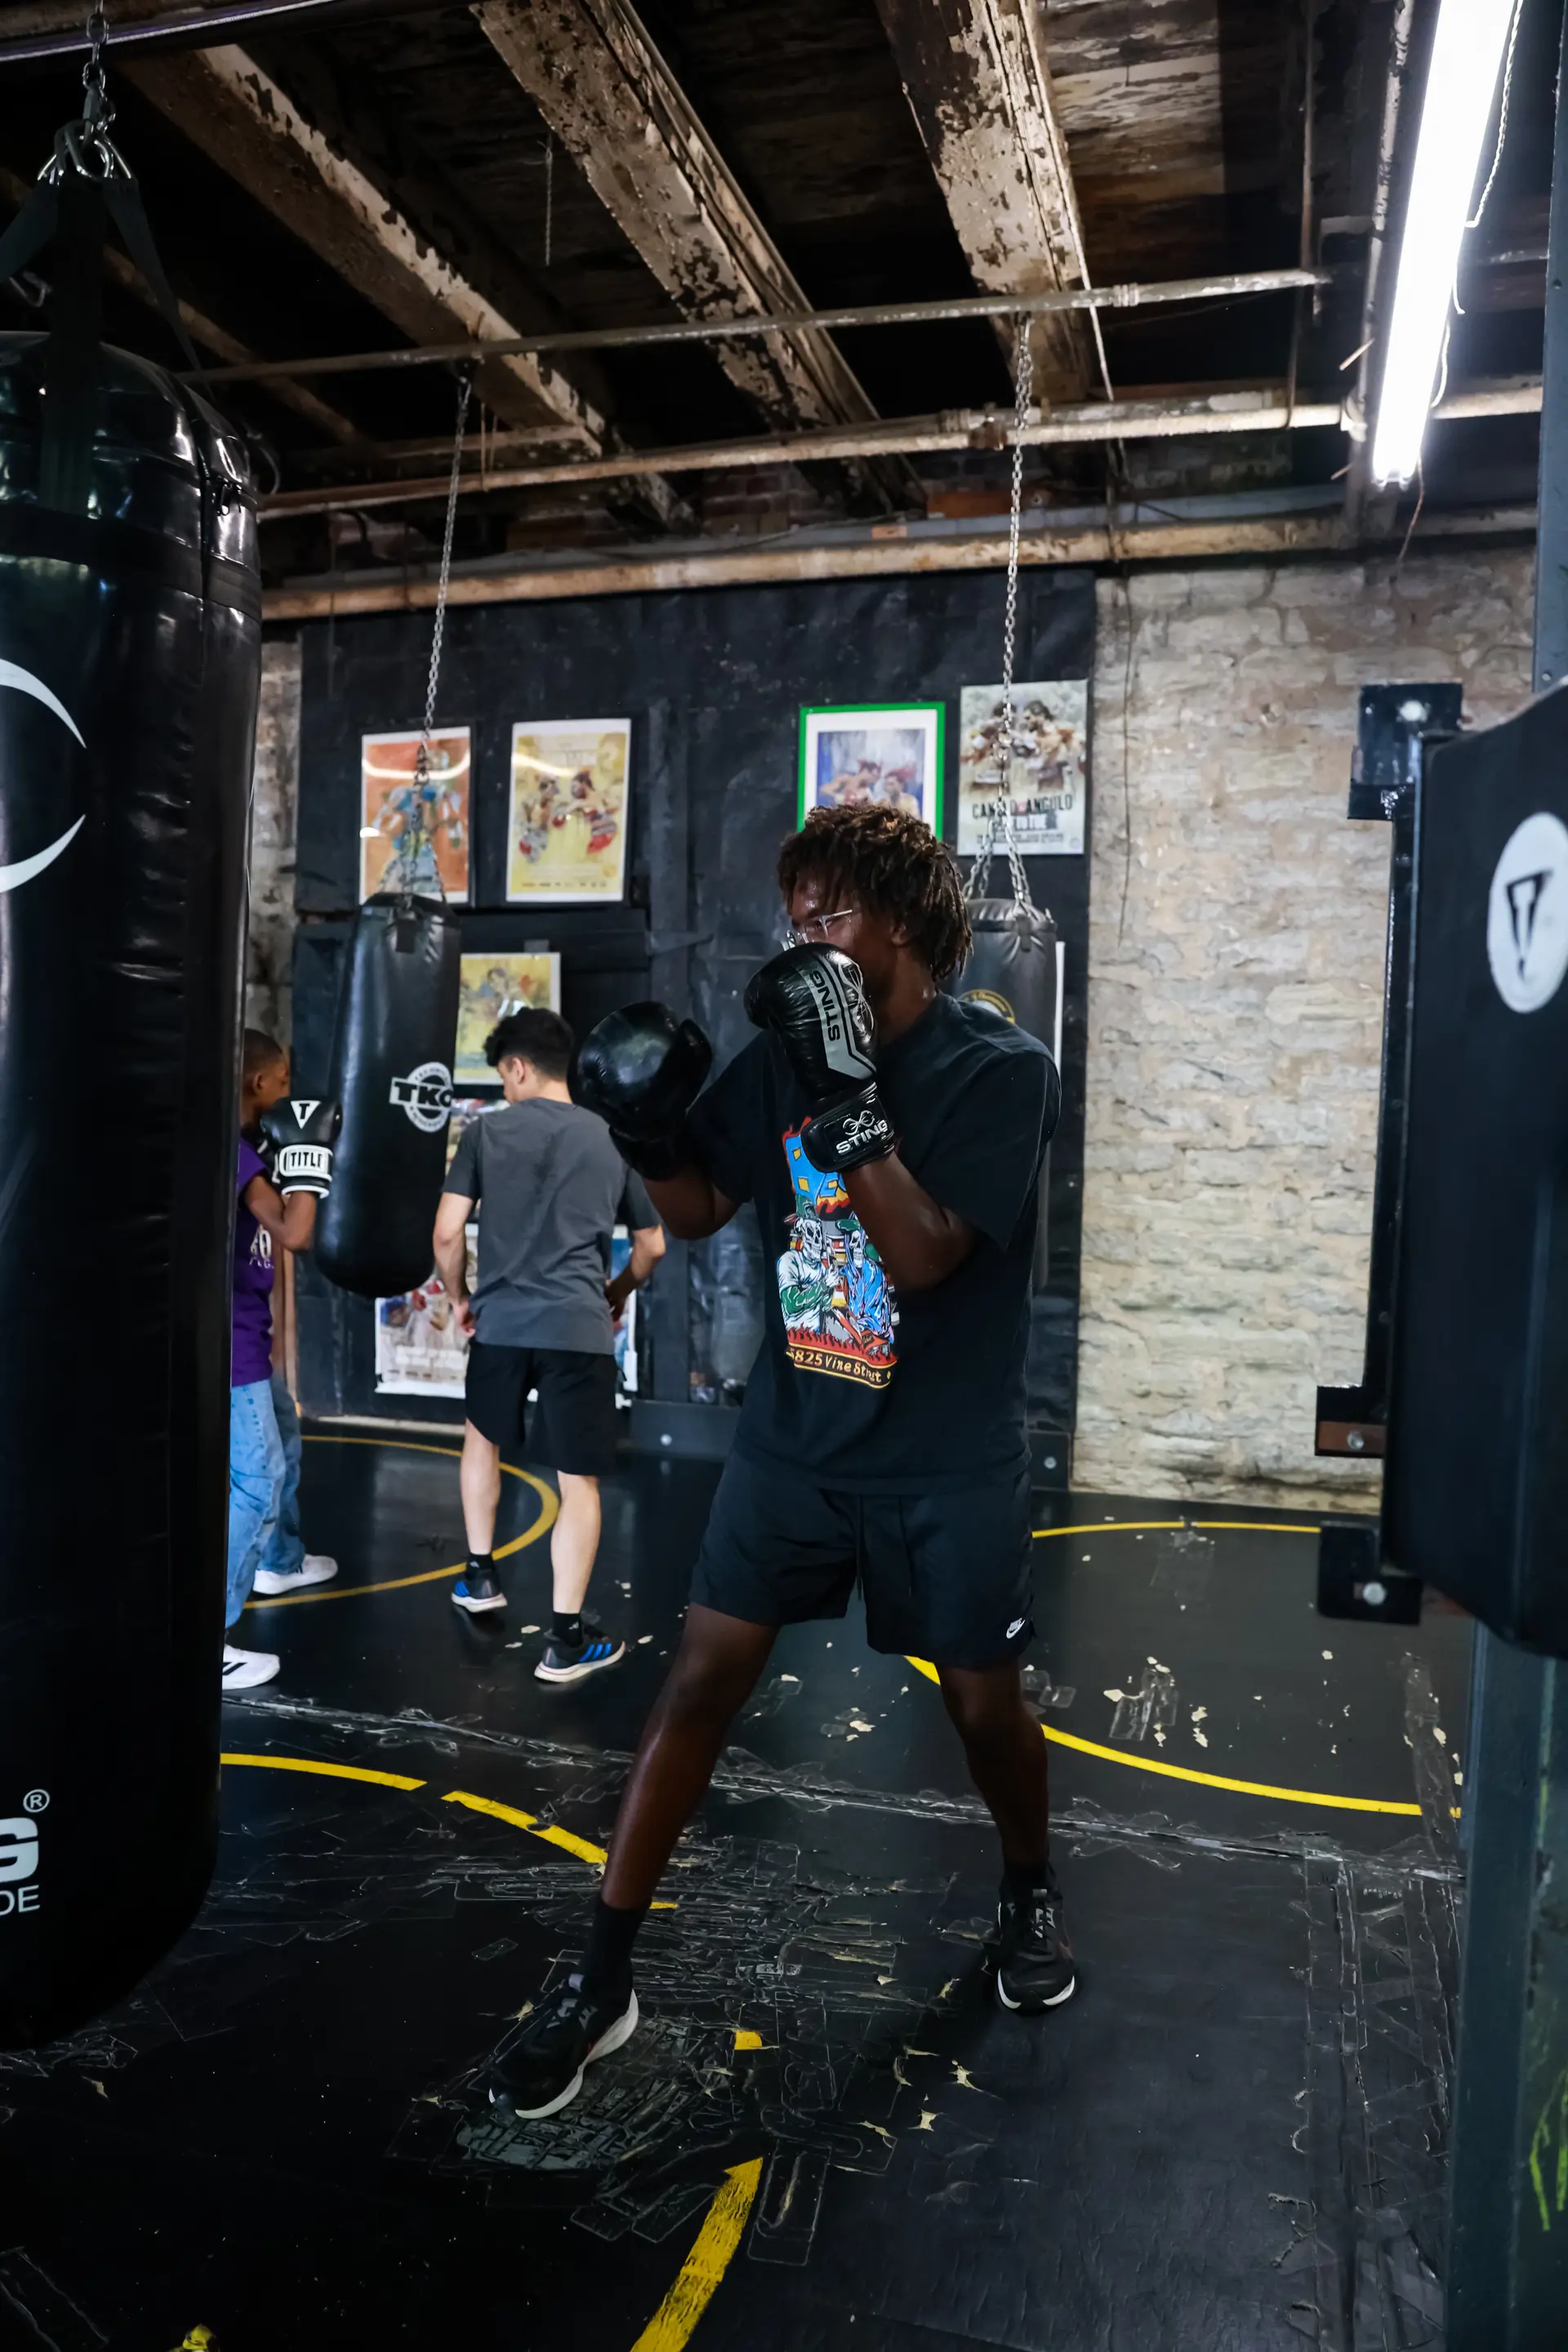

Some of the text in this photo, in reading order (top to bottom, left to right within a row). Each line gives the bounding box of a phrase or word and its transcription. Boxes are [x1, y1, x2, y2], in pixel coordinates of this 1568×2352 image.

[1027, 794, 1073, 814] ANGULO
[809, 970, 840, 1041] STING
[394, 1081, 452, 1107] TKO
[299, 1103, 310, 1120] T
[836, 1120, 888, 1154] STING
[291, 1152, 323, 1169] TITLE
[826, 1354, 852, 1373] Vine
